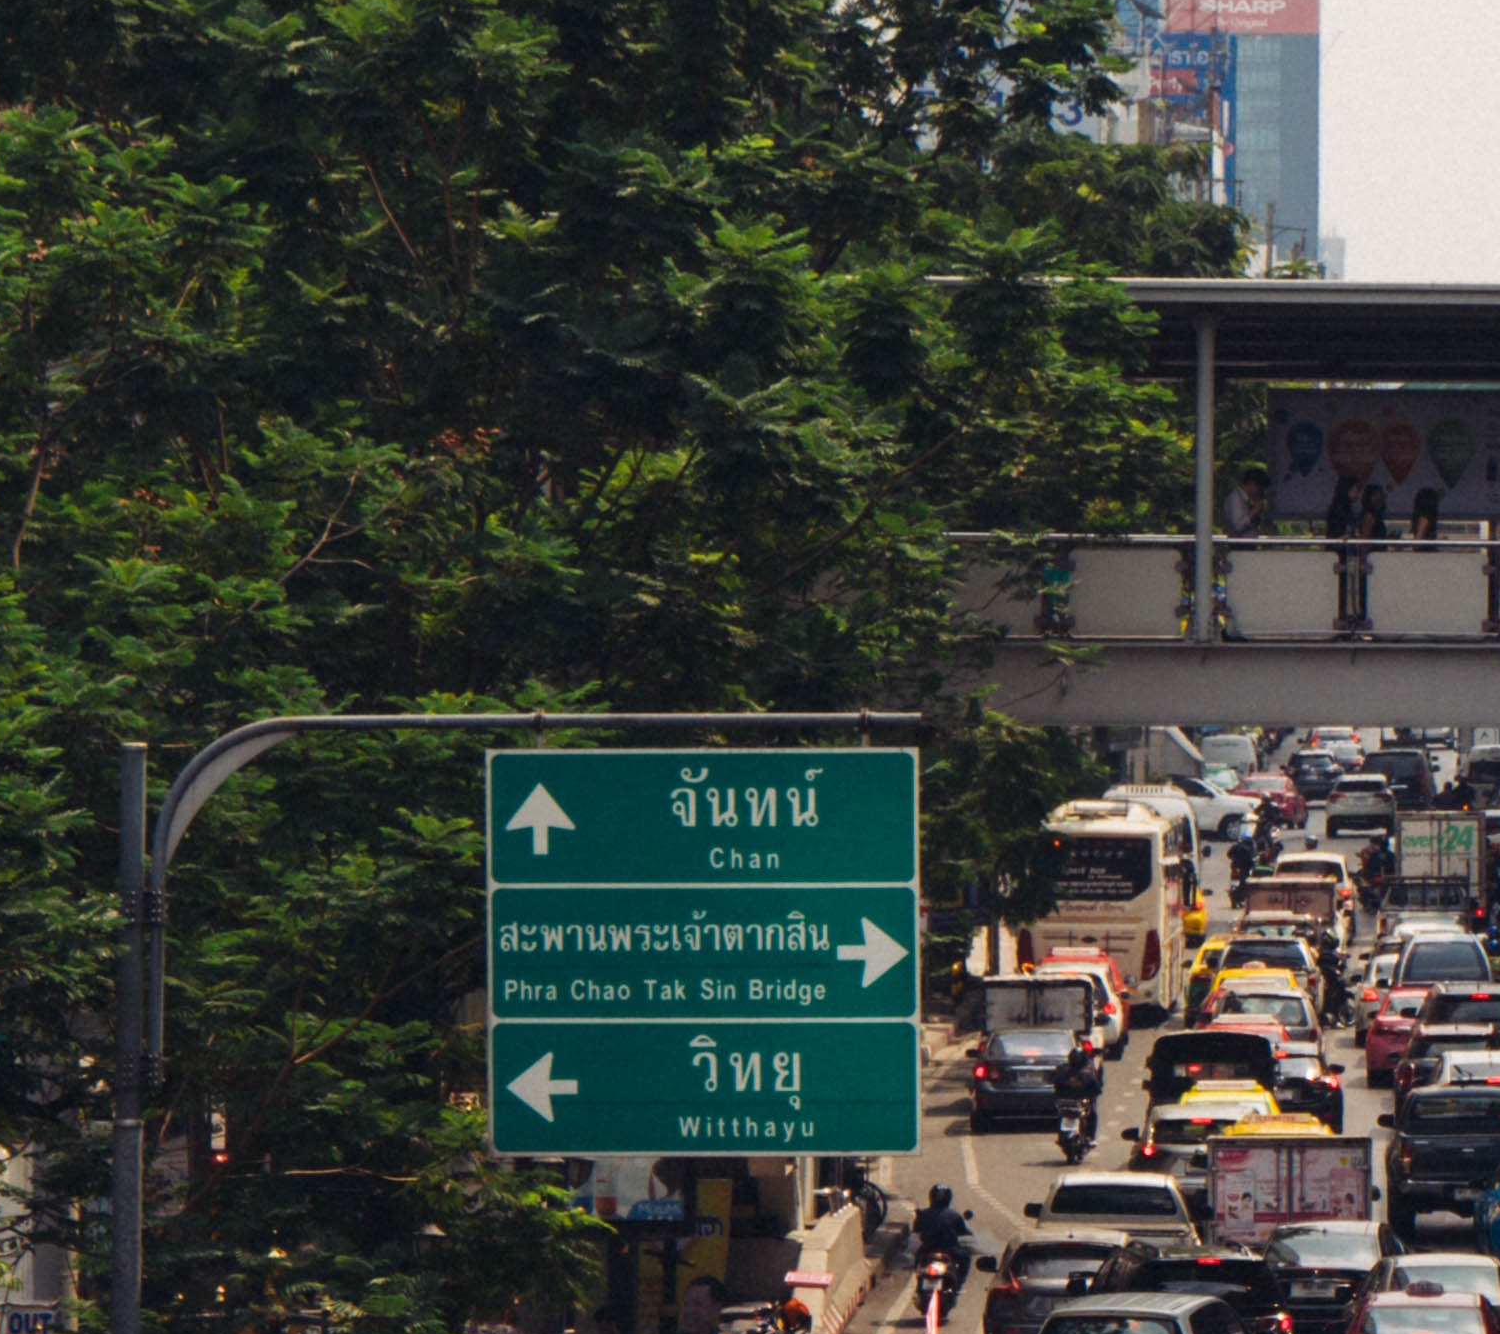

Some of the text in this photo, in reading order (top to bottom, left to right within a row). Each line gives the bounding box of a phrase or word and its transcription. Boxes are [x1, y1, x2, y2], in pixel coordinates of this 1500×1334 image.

[671, 768, 823, 826] จันทน์
[710, 848, 780, 869] Chan
[500, 911, 830, 952] สะพานพระเจ้าตากสิน
[504, 979, 827, 1005] Phra Chao Tak Sin Bridge
[689, 1034, 801, 1109] วิทยุ
[679, 1116, 815, 1142] Witthayu
[9, 1312, 52, 1334] OUT
